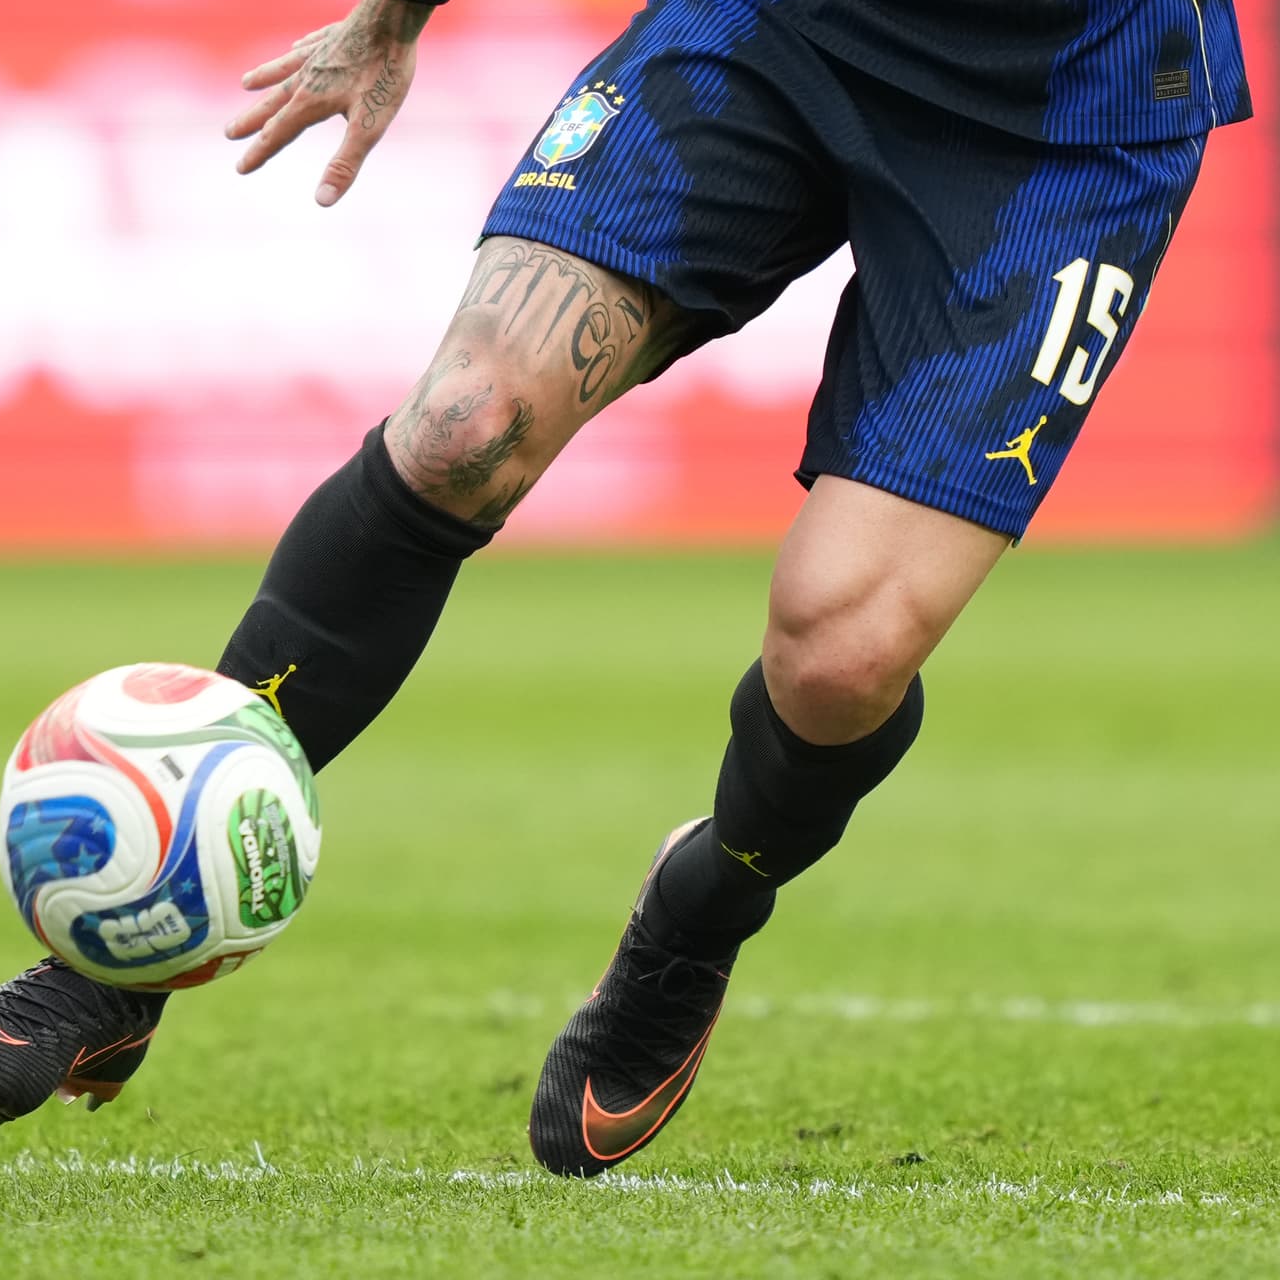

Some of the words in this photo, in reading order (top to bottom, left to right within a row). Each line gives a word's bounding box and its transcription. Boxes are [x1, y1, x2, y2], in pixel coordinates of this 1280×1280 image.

[559, 122, 583, 132] CBF
[513, 171, 577, 191] BRASIL
[1030, 256, 1135, 406] 15
[238, 818, 266, 915] TRIONDA
